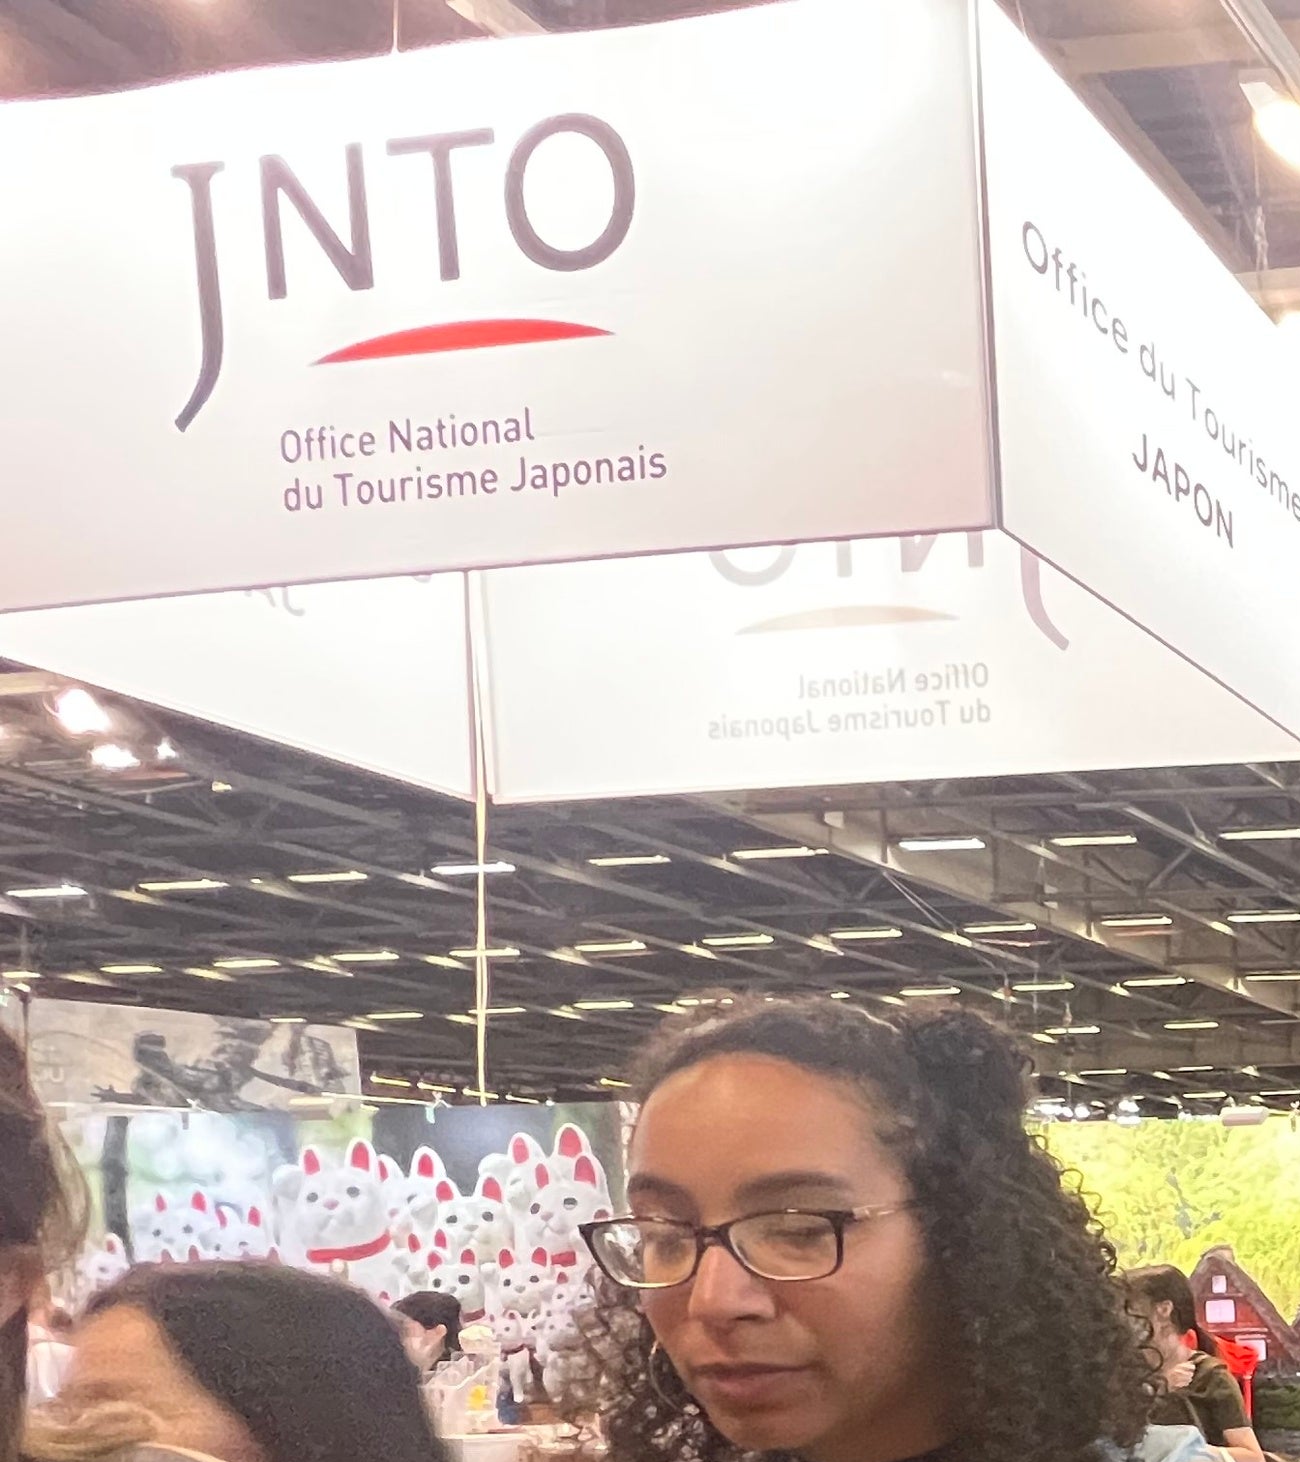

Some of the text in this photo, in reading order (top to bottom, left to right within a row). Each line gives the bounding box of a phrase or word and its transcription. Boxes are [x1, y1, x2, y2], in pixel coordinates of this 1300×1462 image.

[171, 112, 635, 432] JNTO
[1022, 221, 1127, 353] Office
[1140, 342, 1175, 399] du
[280, 408, 535, 463] Office National
[283, 445, 667, 512] du Tourisme Japonais
[1133, 434, 1233, 548] JAPON
